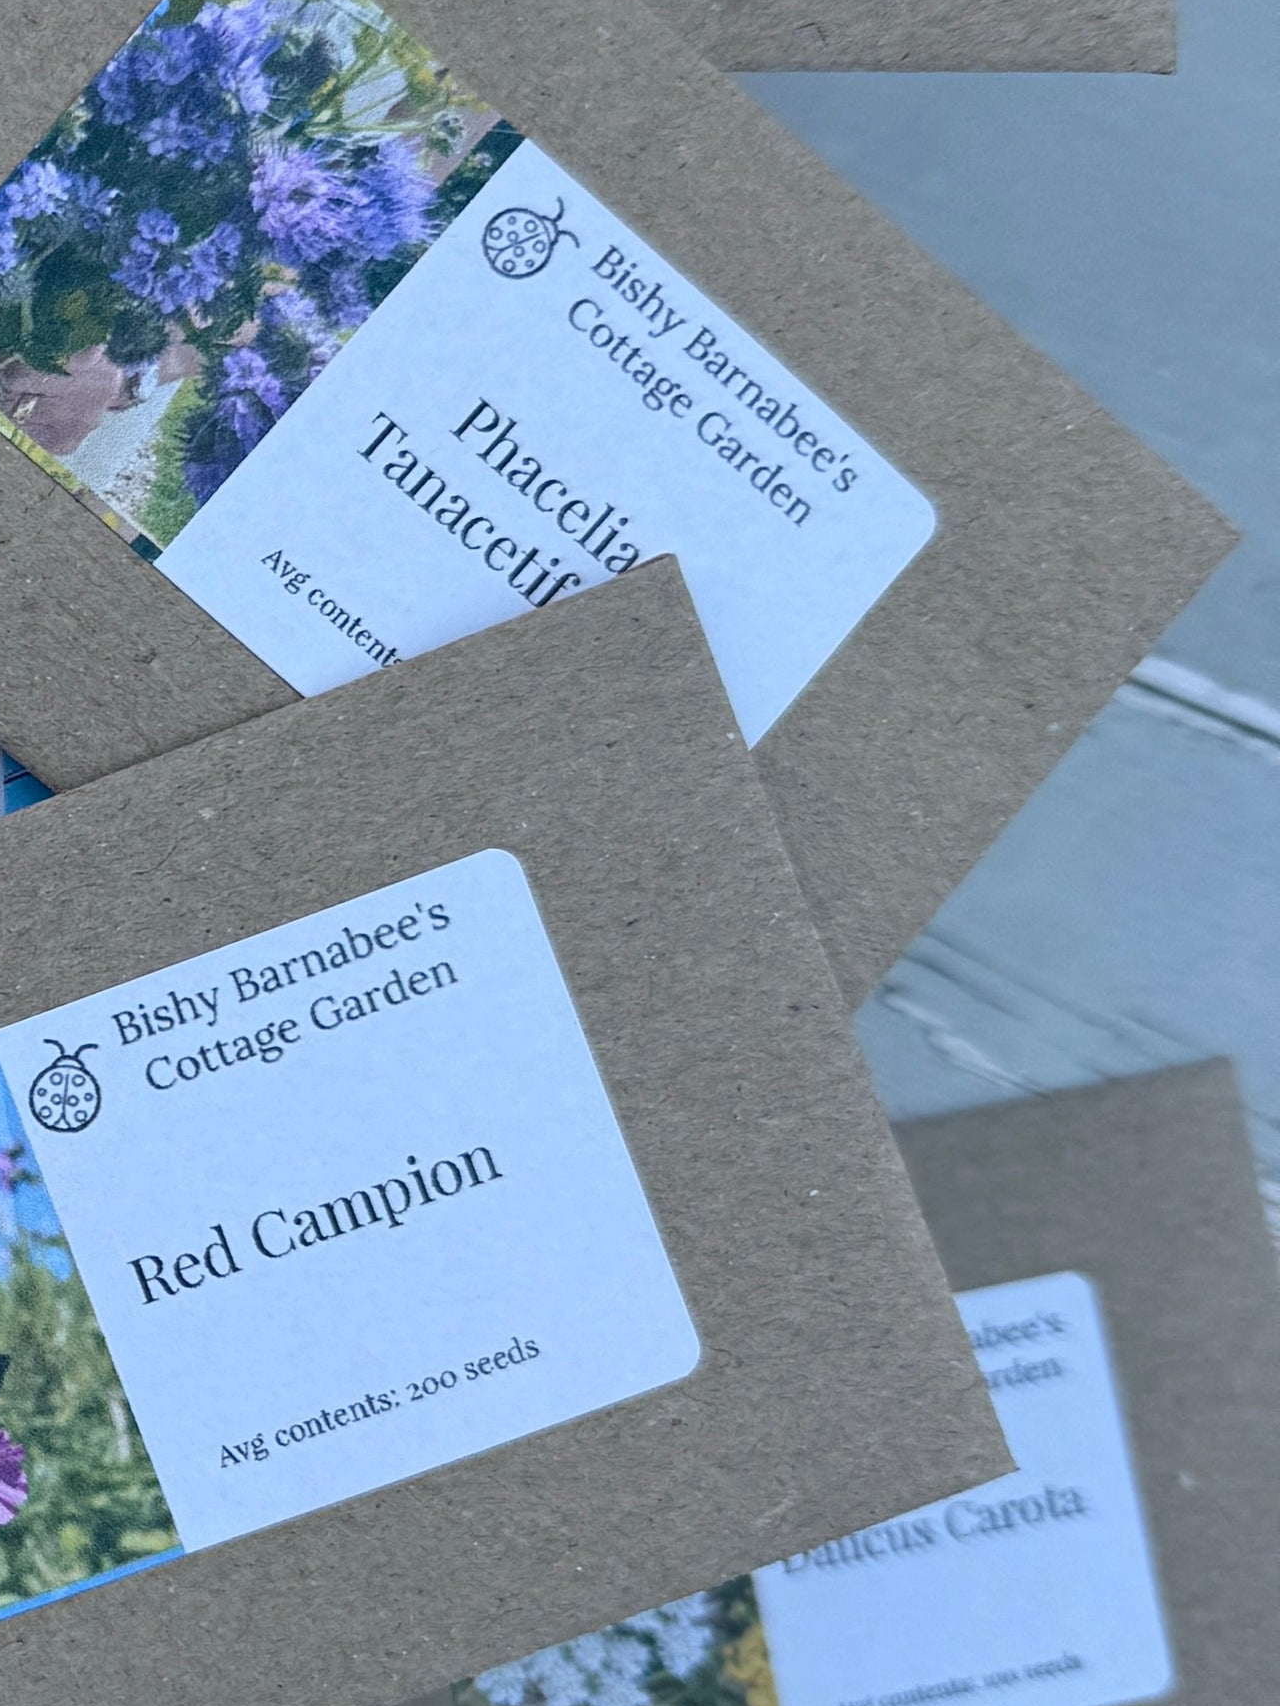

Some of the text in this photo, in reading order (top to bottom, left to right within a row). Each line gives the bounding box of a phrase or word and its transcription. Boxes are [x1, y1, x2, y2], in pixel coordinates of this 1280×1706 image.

[567, 297, 815, 529] Cottage Garden
[590, 244, 860, 494] Bishy Barnabee's
[451, 397, 641, 575] Phacelia
[261, 547, 310, 594] Avg
[112, 900, 451, 1046] Bishy Barnabee's
[145, 959, 459, 1092] Cottage Garden
[127, 1143, 503, 1304] Red Campion
[218, 1335, 540, 1468] Avg contents: 200 seeds
[945, 1485, 1087, 1541] Carota
